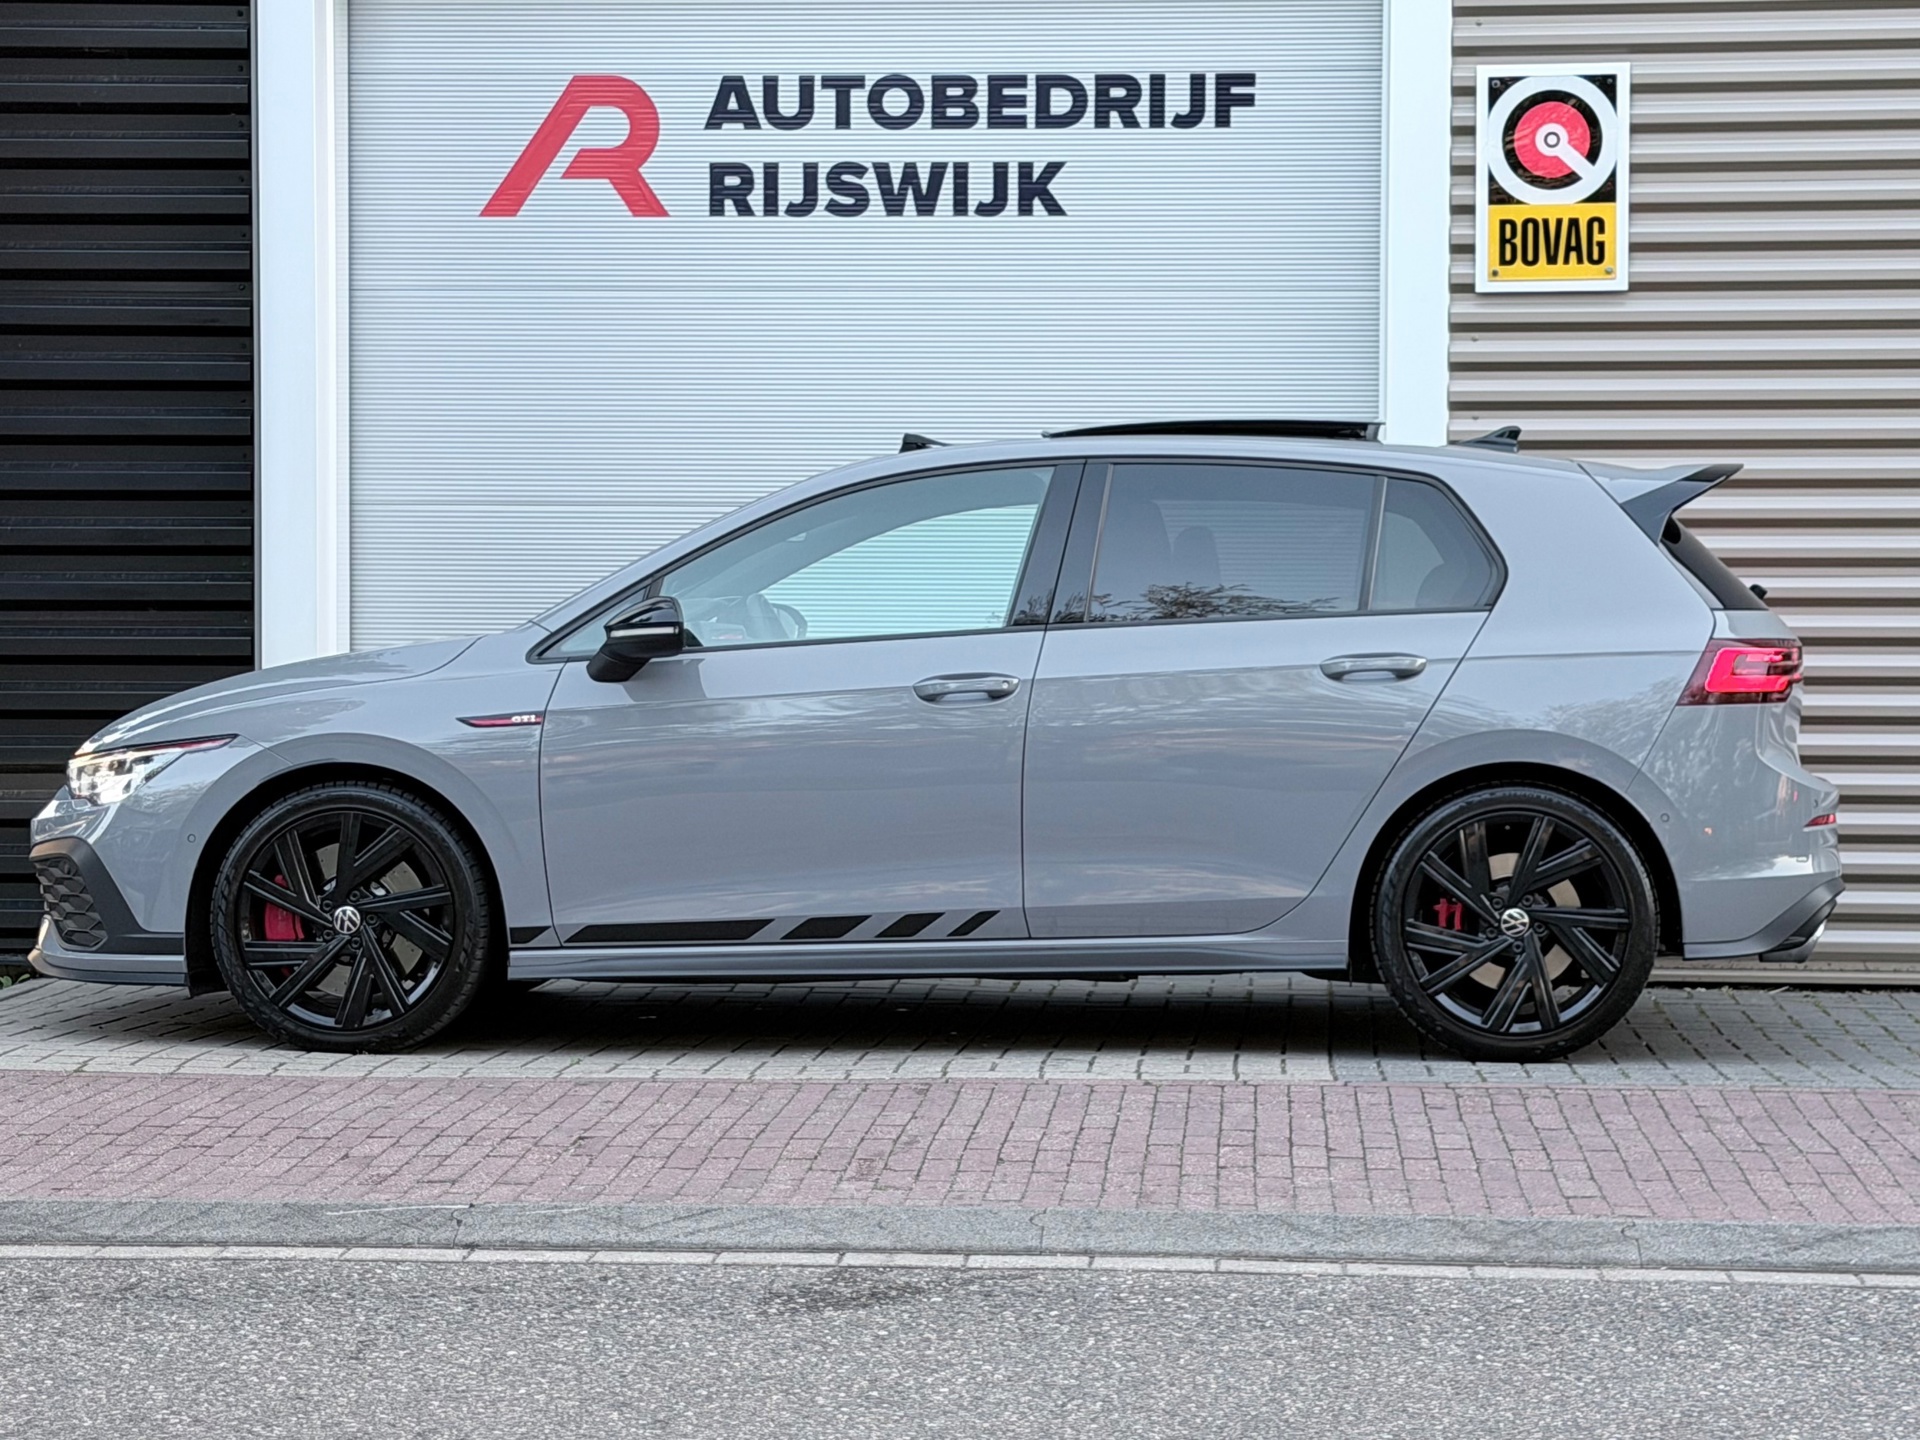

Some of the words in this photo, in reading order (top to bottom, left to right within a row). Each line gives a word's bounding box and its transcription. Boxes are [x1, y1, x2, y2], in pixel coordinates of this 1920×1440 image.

[704, 73, 1256, 131] AUTOBEDRIJF
[708, 162, 1068, 218] RIJSWIJK
[1498, 216, 1606, 267] BOVAG
[511, 714, 536, 723] GTI
